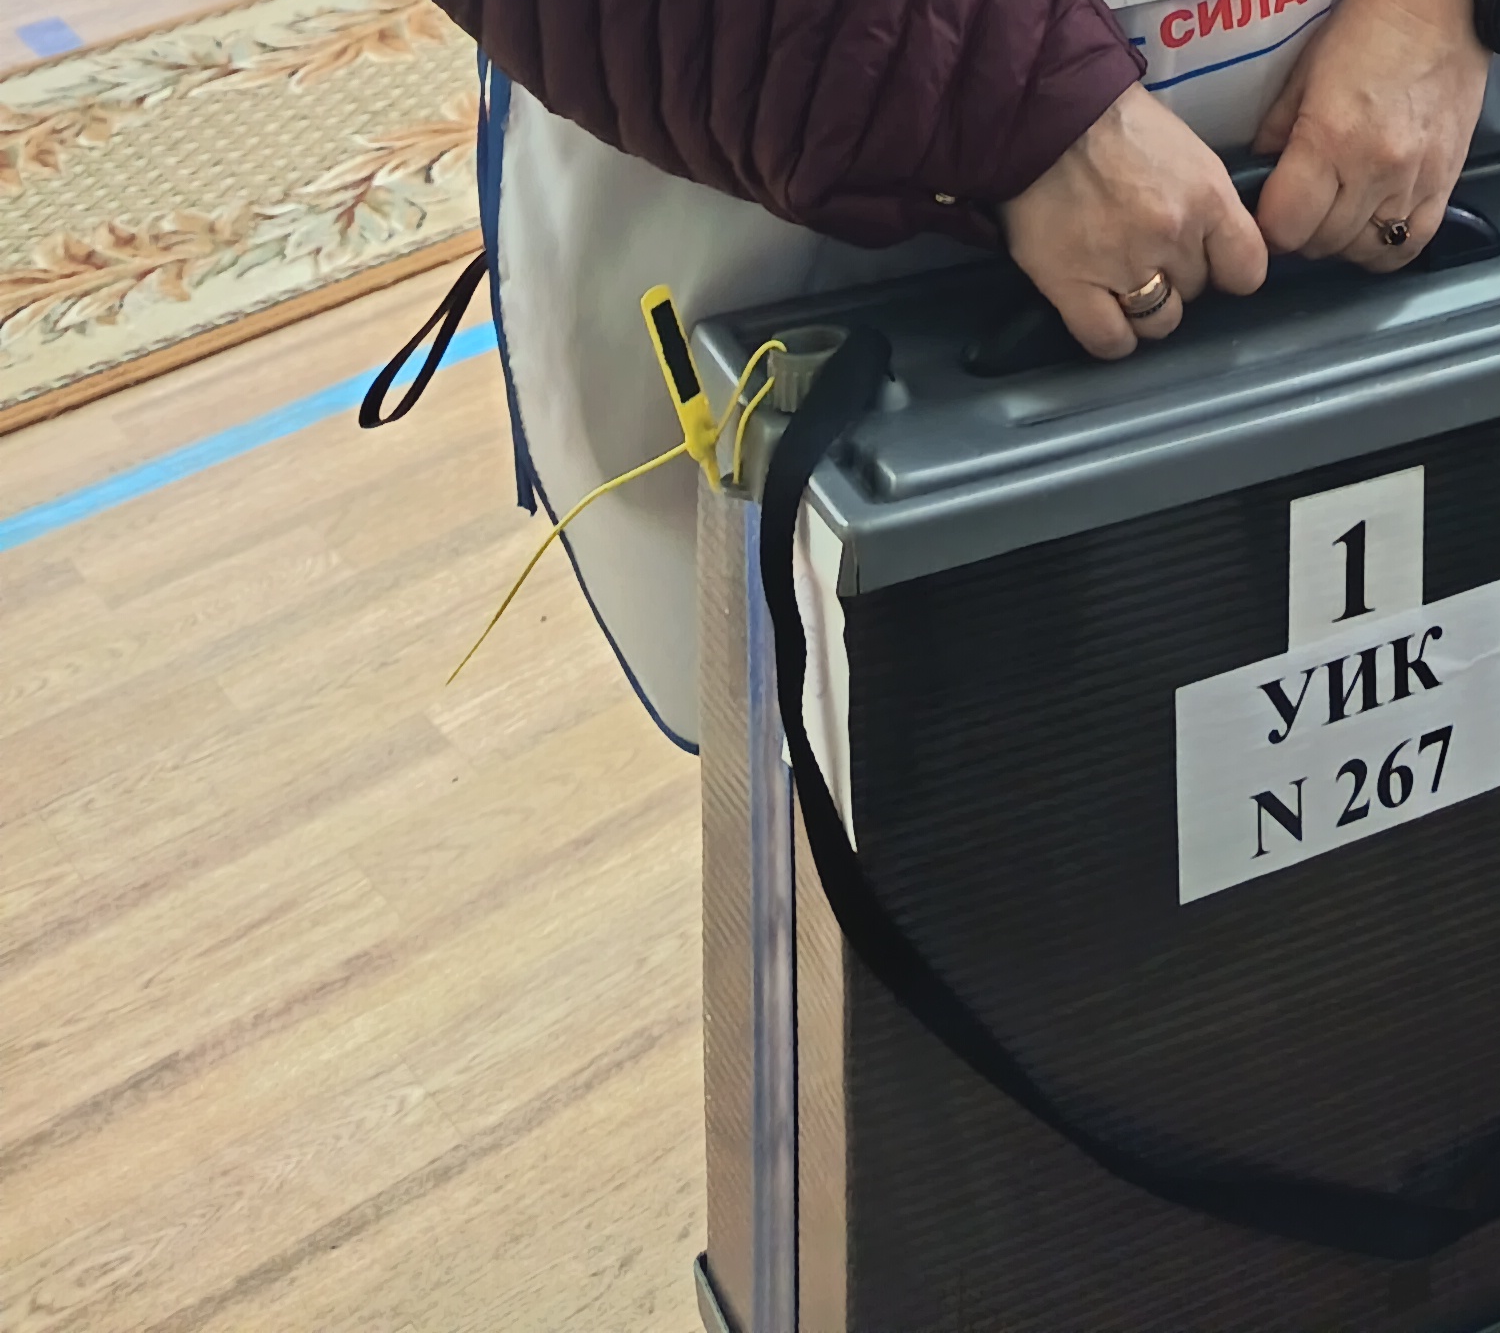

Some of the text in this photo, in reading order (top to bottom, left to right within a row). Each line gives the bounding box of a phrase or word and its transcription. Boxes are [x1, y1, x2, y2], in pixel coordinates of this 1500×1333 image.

[1332, 519, 1376, 623] 1
[1256, 625, 1444, 745] УИК
[1248, 724, 1454, 860] N 267
